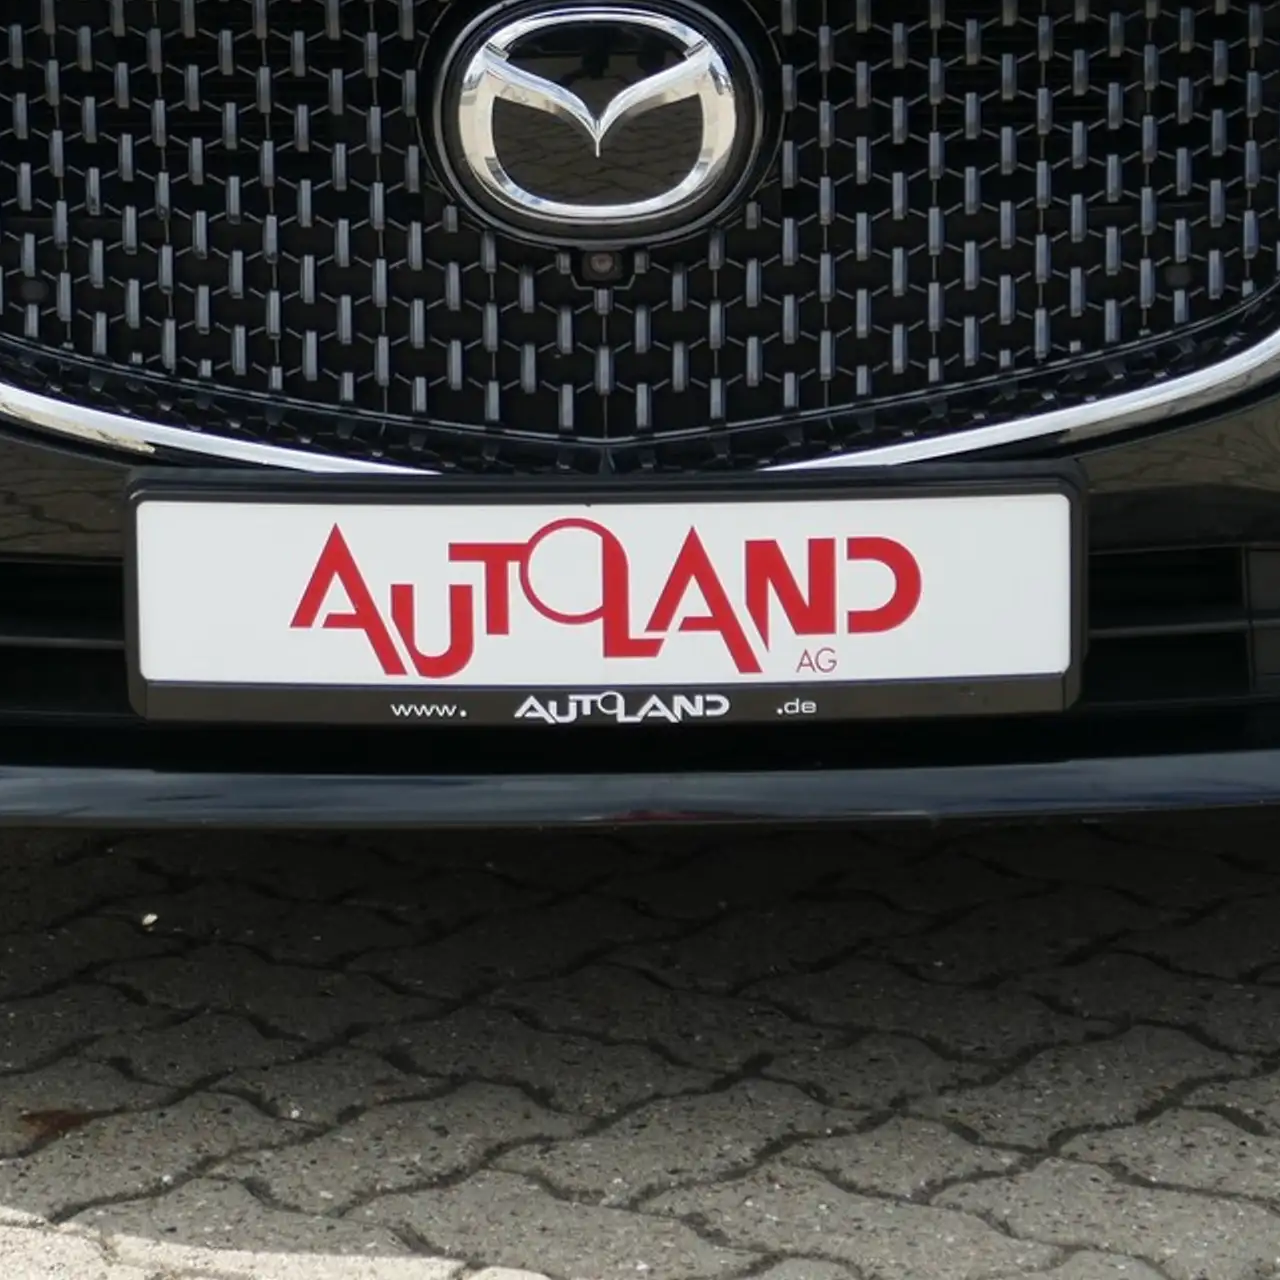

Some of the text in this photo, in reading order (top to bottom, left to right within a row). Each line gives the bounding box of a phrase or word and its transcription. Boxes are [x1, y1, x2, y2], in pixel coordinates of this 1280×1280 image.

[289, 516, 923, 680] AUTOLAND
[796, 648, 837, 673] AG
[390, 690, 818, 724] www. AUTOLAND .de
